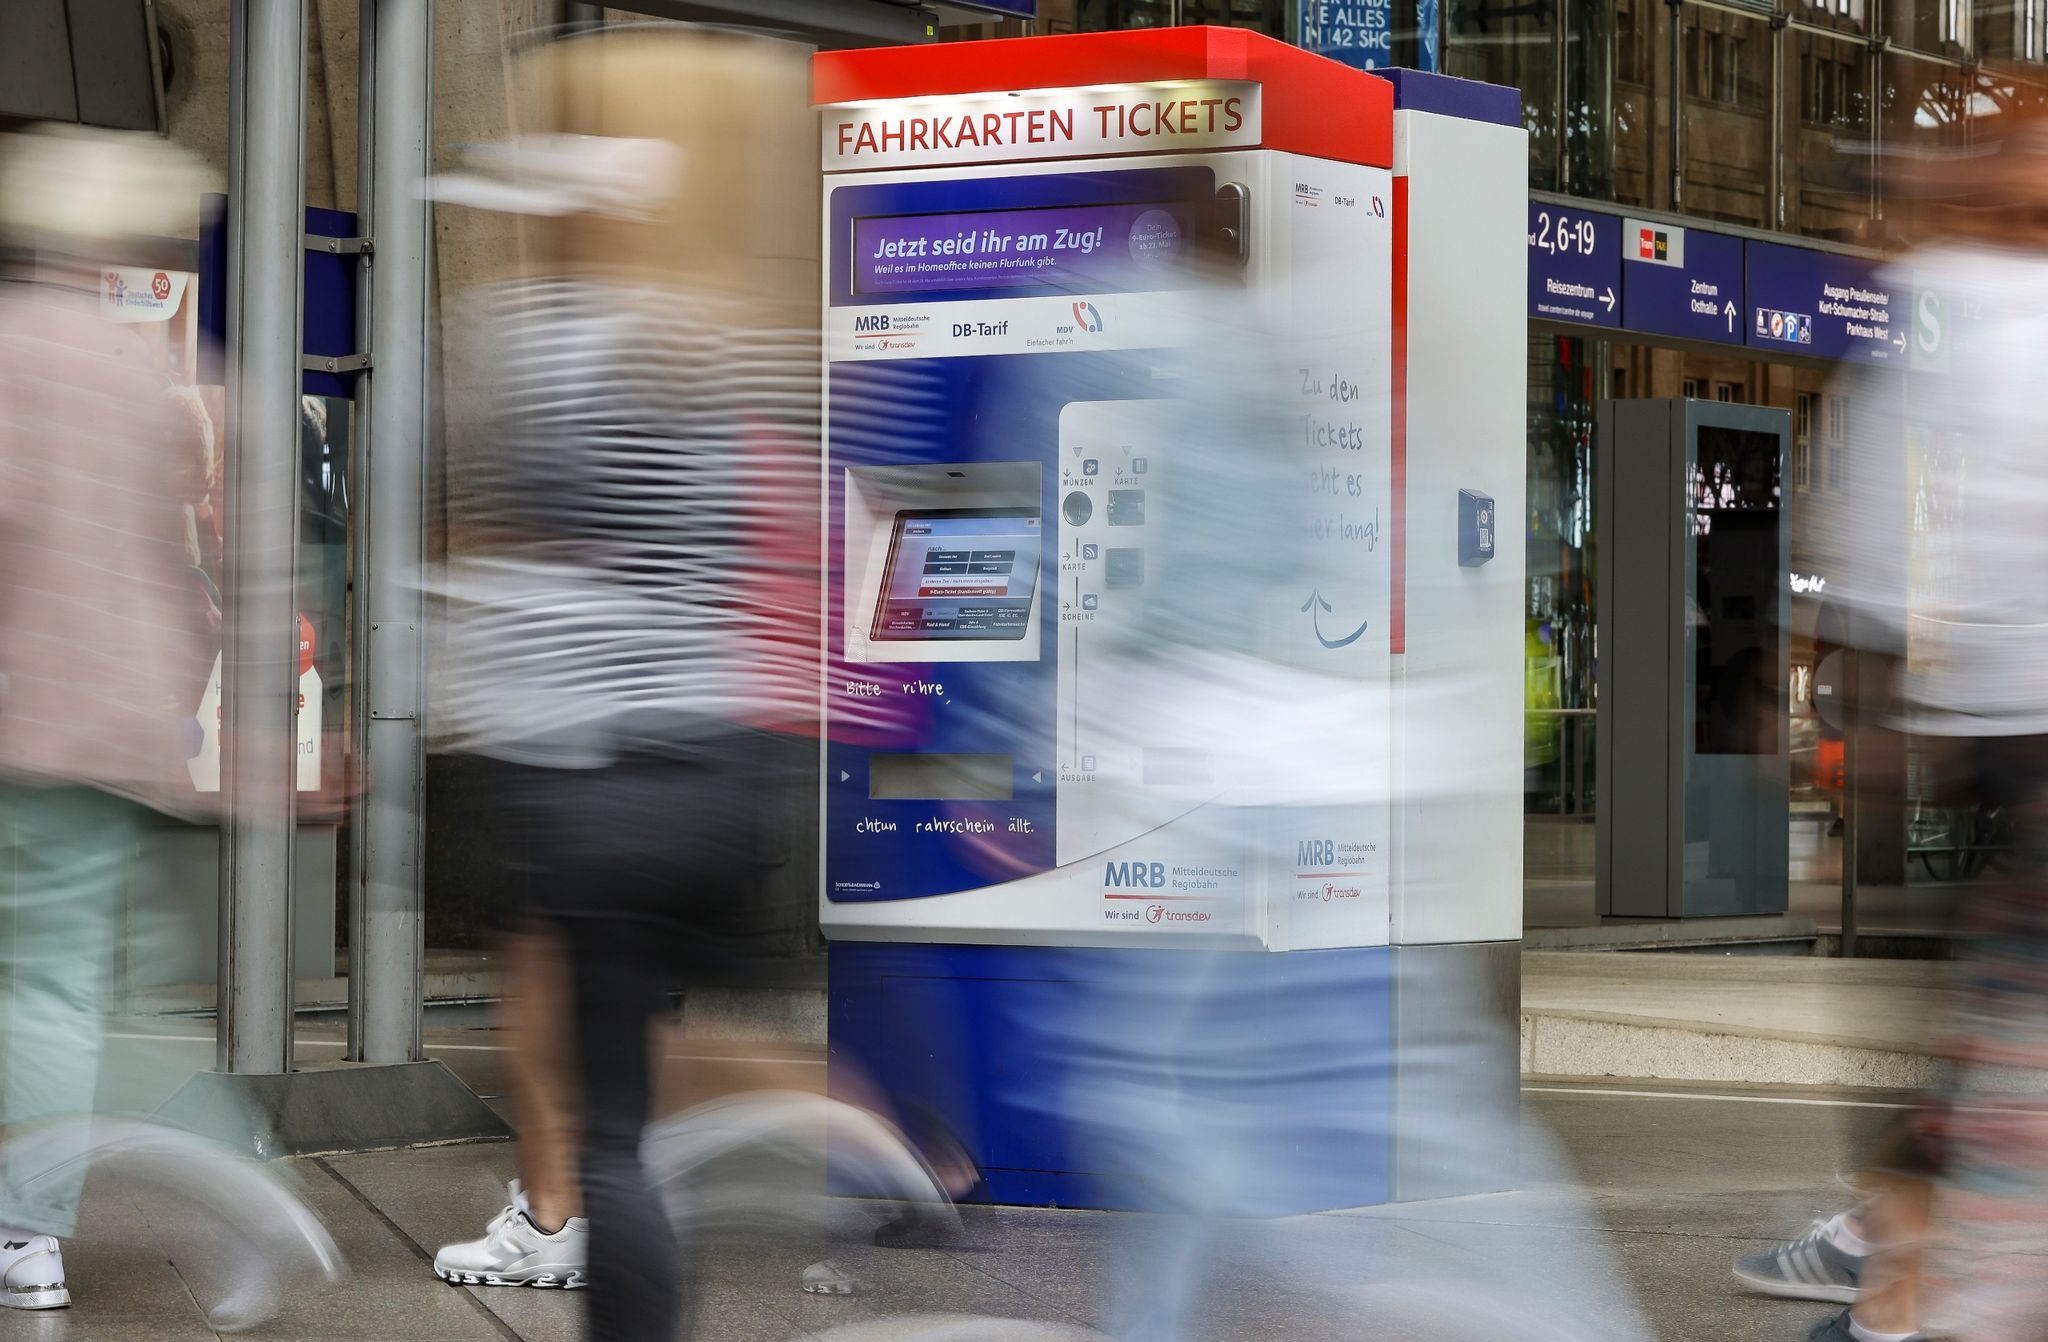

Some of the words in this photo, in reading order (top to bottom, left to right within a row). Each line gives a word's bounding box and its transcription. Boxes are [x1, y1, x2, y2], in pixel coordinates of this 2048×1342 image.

[1335, 7, 1386, 28] ALLES
[838, 107, 1074, 156] FAHRKARTEN
[1094, 97, 1243, 139] TICKETS
[1295, 183, 1309, 194] MRB
[1334, 196, 1355, 207] DB-Tarif
[1537, 211, 1595, 255] 2,6-19
[873, 237, 927, 259] Jetzt
[931, 230, 977, 257] seid
[981, 229, 1012, 253] ihr
[1015, 233, 1048, 252] am
[1053, 226, 1103, 254] Zug!
[1640, 238, 1653, 250] Tram
[874, 264, 893, 275] Weil
[894, 265, 903, 274] es
[905, 263, 916, 273] im
[917, 260, 967, 273] Homeoffice
[968, 259, 998, 270] keinen
[999, 257, 1035, 268] Flurfunk
[1037, 256, 1057, 268] gibt.
[154, 278, 169, 294] 50
[1547, 278, 1595, 299] Reisezentrum
[1691, 279, 1718, 296] Zentrum
[1823, 283, 1849, 302] Ausgang
[1691, 298, 1718, 315] Osthalle
[855, 315, 890, 331] MRB
[952, 320, 1009, 338] DB-Tarif
[1056, 326, 1074, 334] MDV
[1026, 339, 1055, 347] Einfacher
[1299, 368, 1322, 395] Zu
[1329, 373, 1359, 402] den
[1301, 413, 1363, 450] Tickets
[1063, 477, 1094, 487] MÜNZEN
[1114, 477, 1139, 486] KARTE
[1346, 473, 1362, 497] es
[1340, 506, 1379, 552] lang!
[1062, 562, 1086, 571] KARTE
[1062, 613, 1095, 621] SCHEINE
[846, 680, 882, 696] Bitte
[1061, 774, 1096, 782] AUSGABE
[1297, 839, 1335, 866] MRB
[1337, 842, 1376, 852] Mitteldeutsche
[1337, 855, 1365, 867] Regiobahn
[1104, 861, 1167, 888] MRB
[1172, 866, 1238, 877] Mitteldeutsche
[1172, 879, 1218, 891] Regiobahn
[1297, 890, 1306, 900] Wir
[1307, 889, 1319, 899] sind
[1333, 887, 1361, 898] transdev
[1105, 910, 1120, 920] Wir
[1121, 910, 1140, 920] sind
[1165, 911, 1212, 921] transdev
